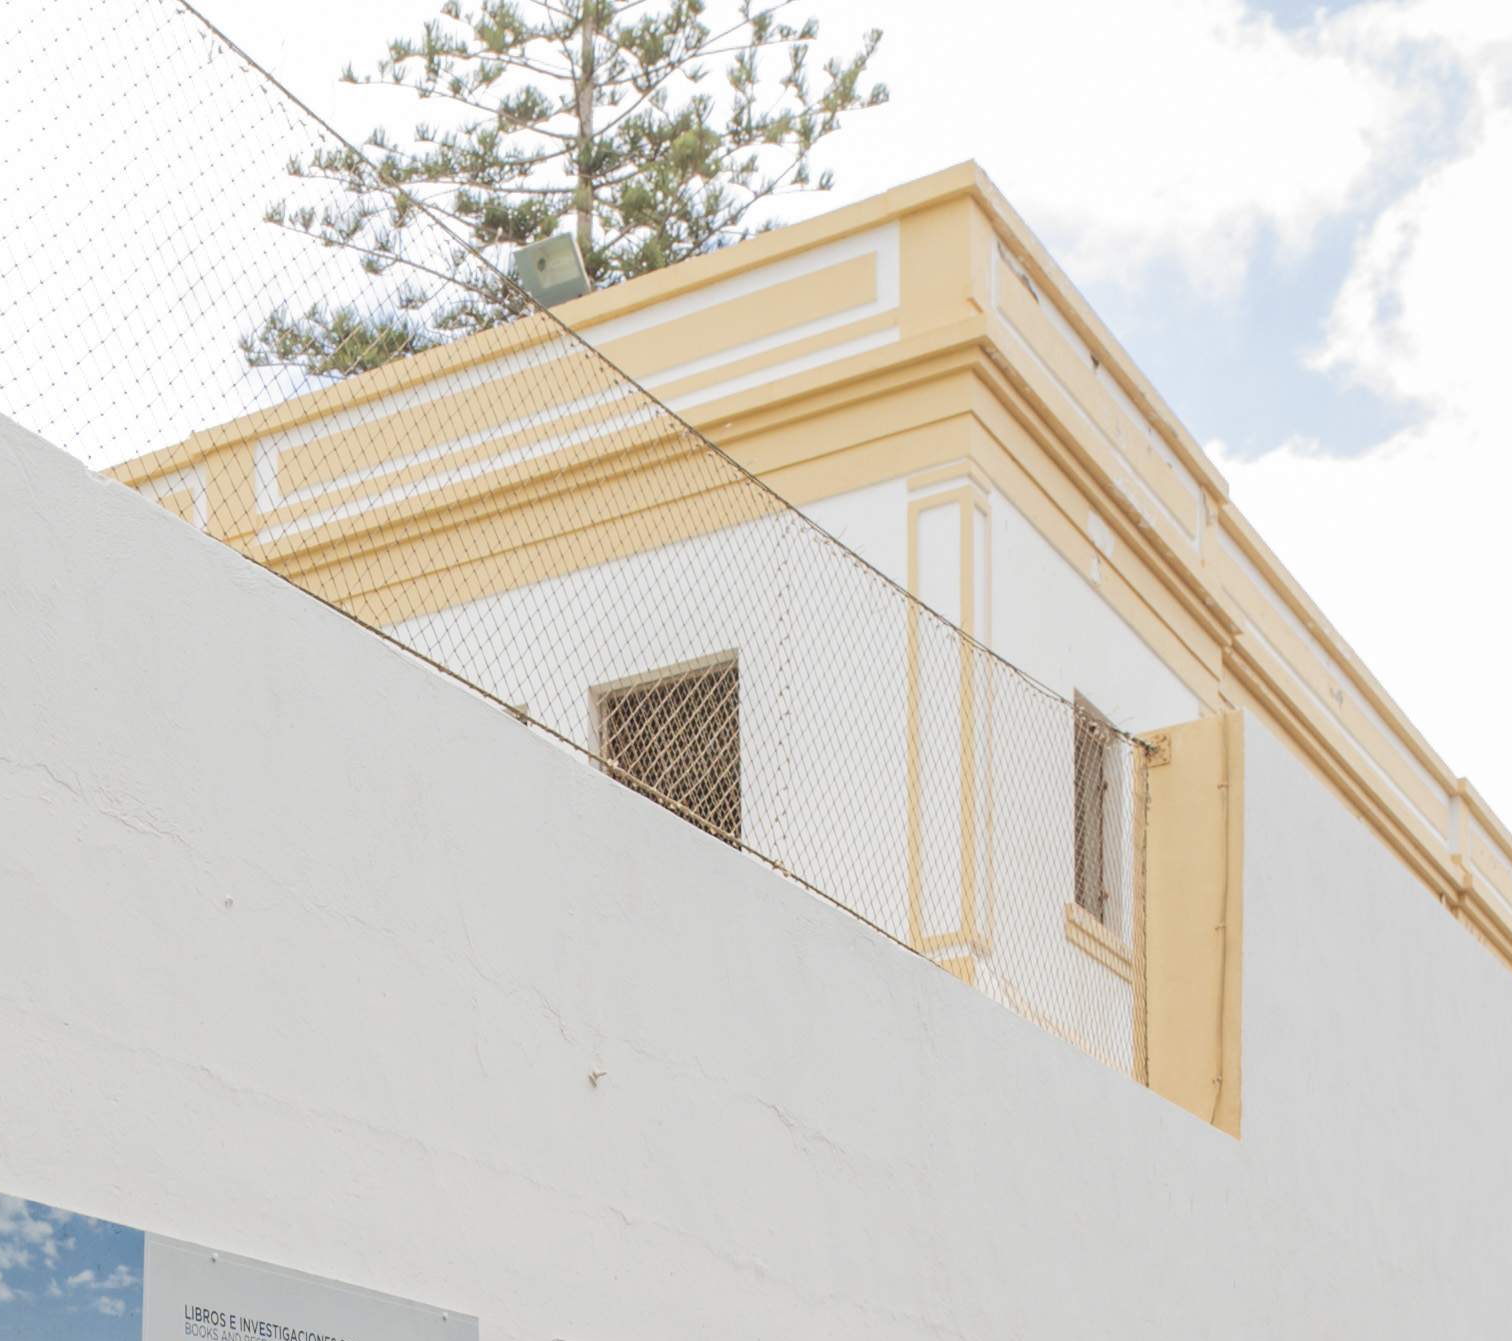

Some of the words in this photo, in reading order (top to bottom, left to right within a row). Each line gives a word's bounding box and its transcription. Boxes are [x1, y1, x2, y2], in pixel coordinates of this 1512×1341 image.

[184, 1304, 226, 1328] LIBROS
[229, 1314, 237, 1330] E
[184, 1320, 219, 1341] BOOKS
